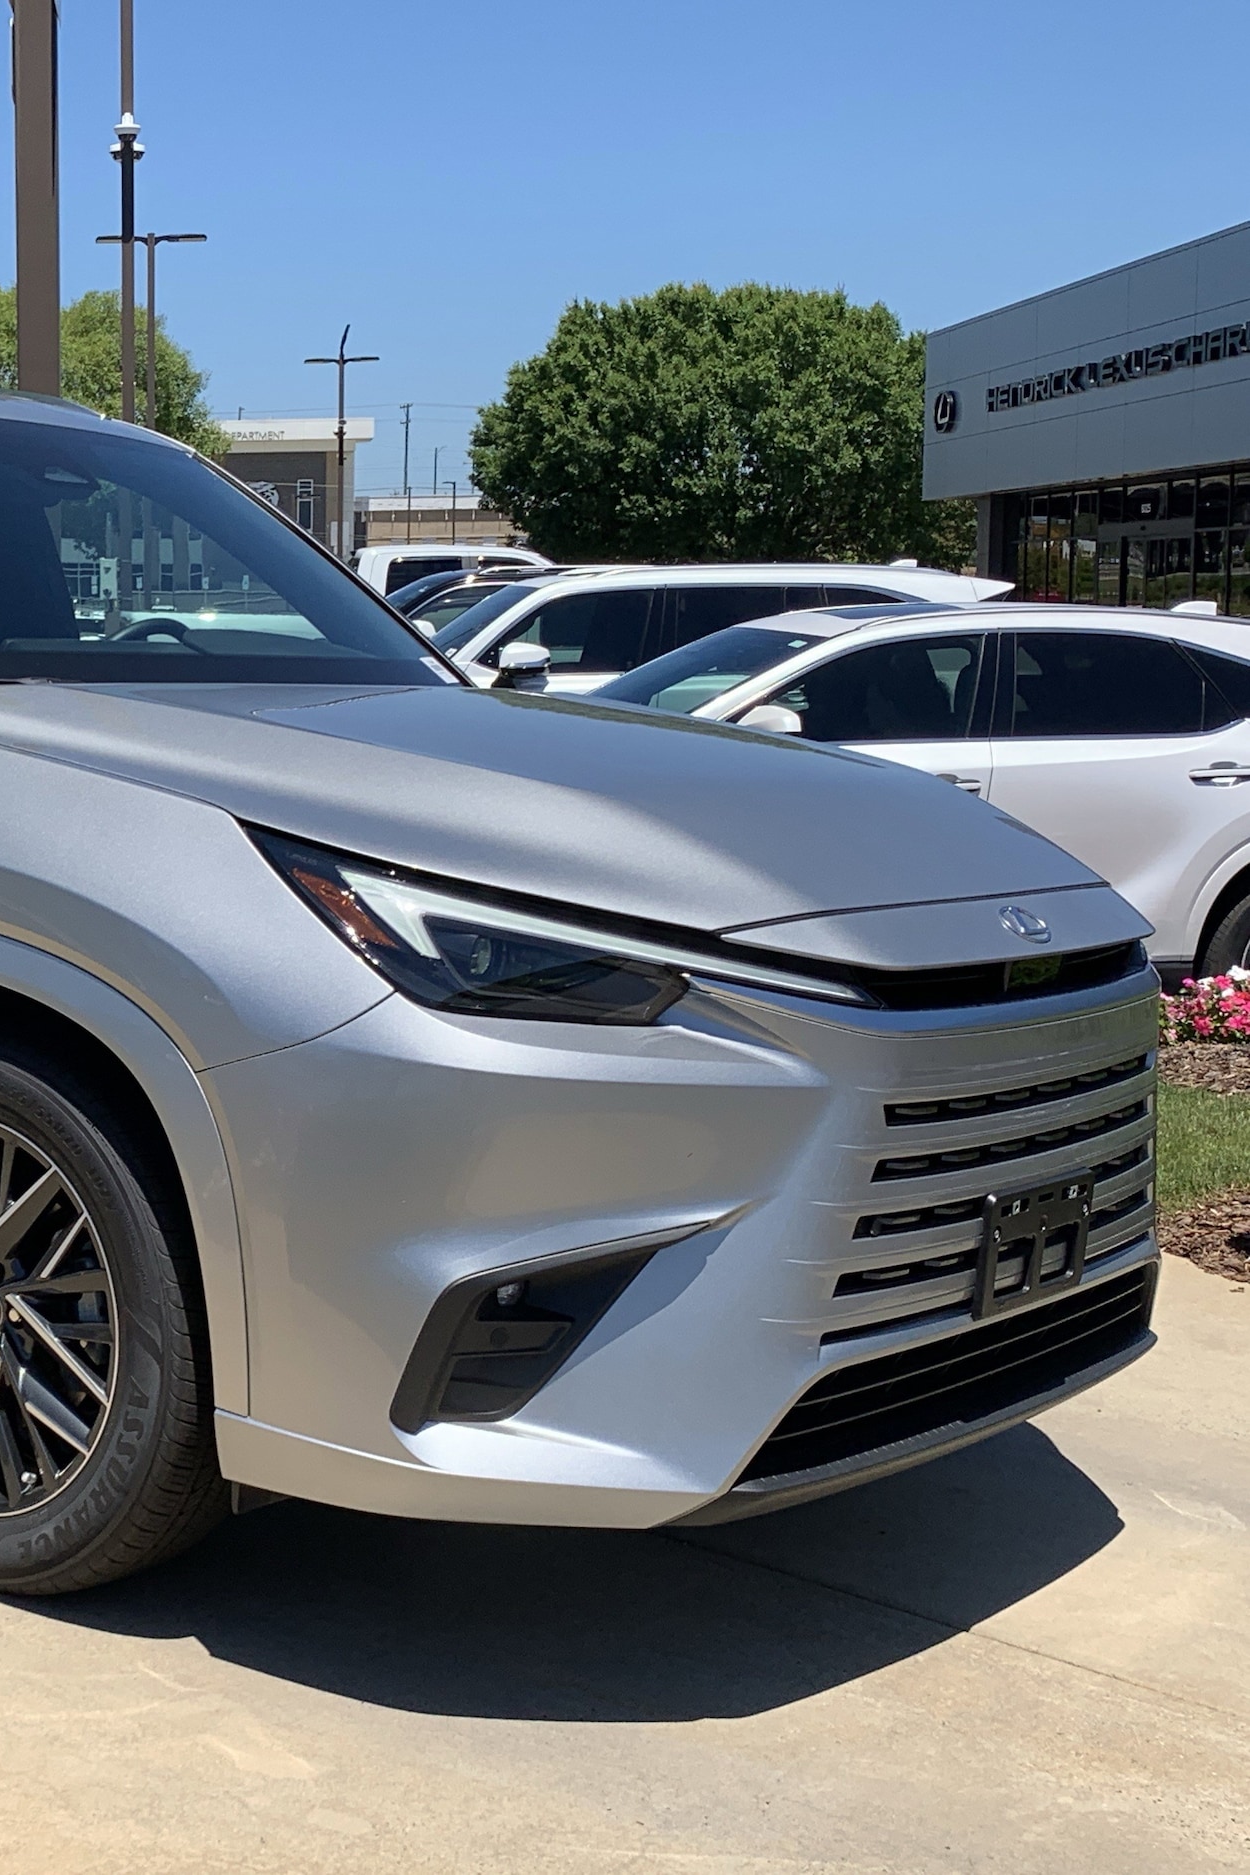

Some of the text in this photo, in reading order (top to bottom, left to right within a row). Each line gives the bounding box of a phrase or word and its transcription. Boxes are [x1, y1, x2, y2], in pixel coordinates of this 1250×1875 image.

[985, 366, 1085, 412] HENDRICK
[1085, 343, 1171, 389] LEXUS
[226, 430, 285, 441] EPARTMENT
[16, 1374, 151, 1560] ASSURANCE
